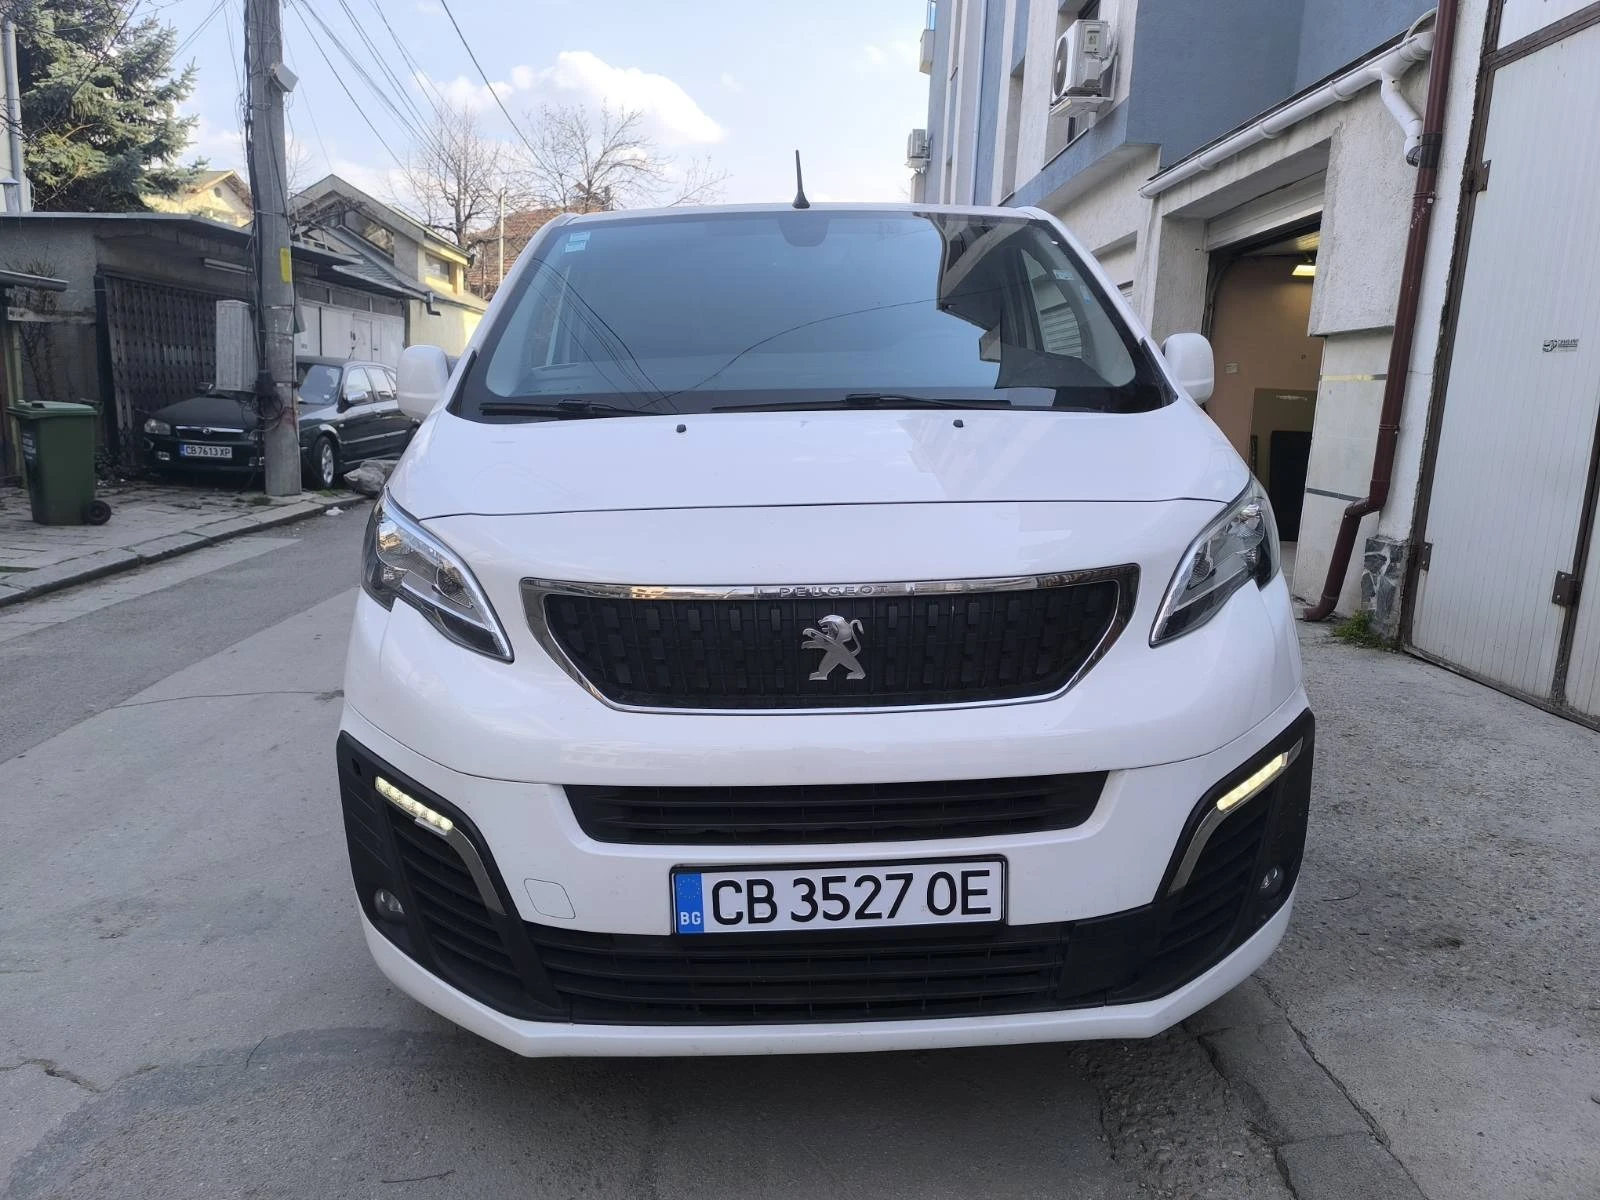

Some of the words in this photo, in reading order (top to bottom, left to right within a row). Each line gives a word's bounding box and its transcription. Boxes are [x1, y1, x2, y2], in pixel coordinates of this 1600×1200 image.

[186, 446, 197, 455] CB
[197, 446, 218, 456] 7613
[219, 447, 231, 457] XP
[780, 585, 889, 597] PEUGEOT
[711, 878, 778, 926] CB
[790, 873, 914, 923] 3527
[926, 869, 992, 916] OE
[680, 911, 702, 926] BG
